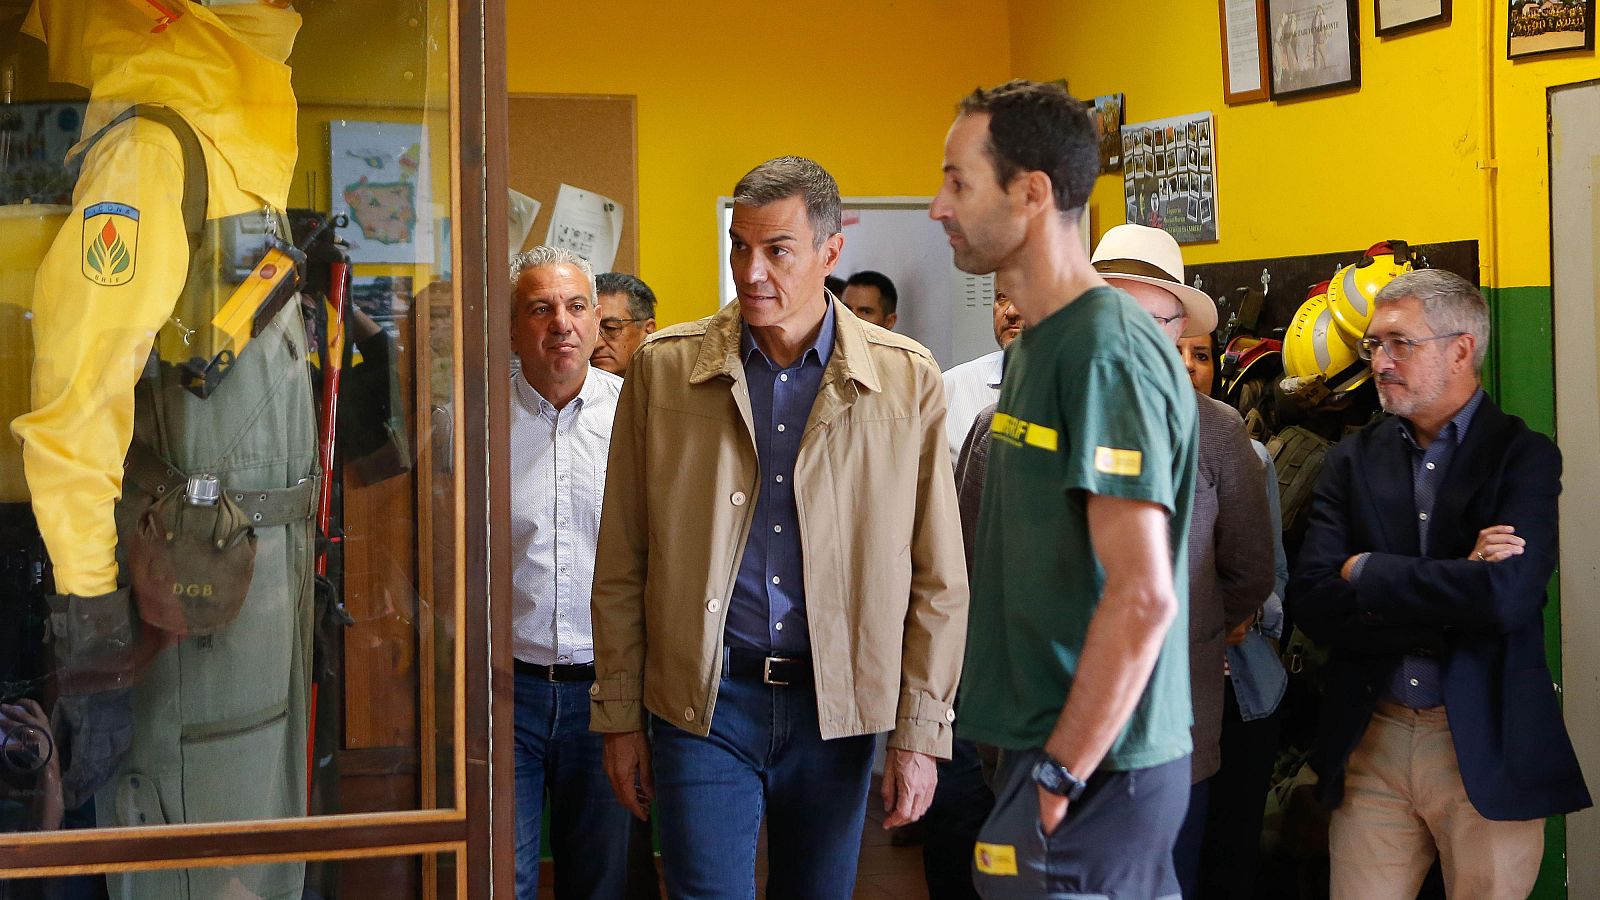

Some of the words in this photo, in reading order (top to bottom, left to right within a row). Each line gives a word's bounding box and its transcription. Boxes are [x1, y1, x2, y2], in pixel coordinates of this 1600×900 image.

[93, 205, 131, 215] ICONA
[94, 274, 120, 283] BRIF
[172, 583, 213, 598] DGB
